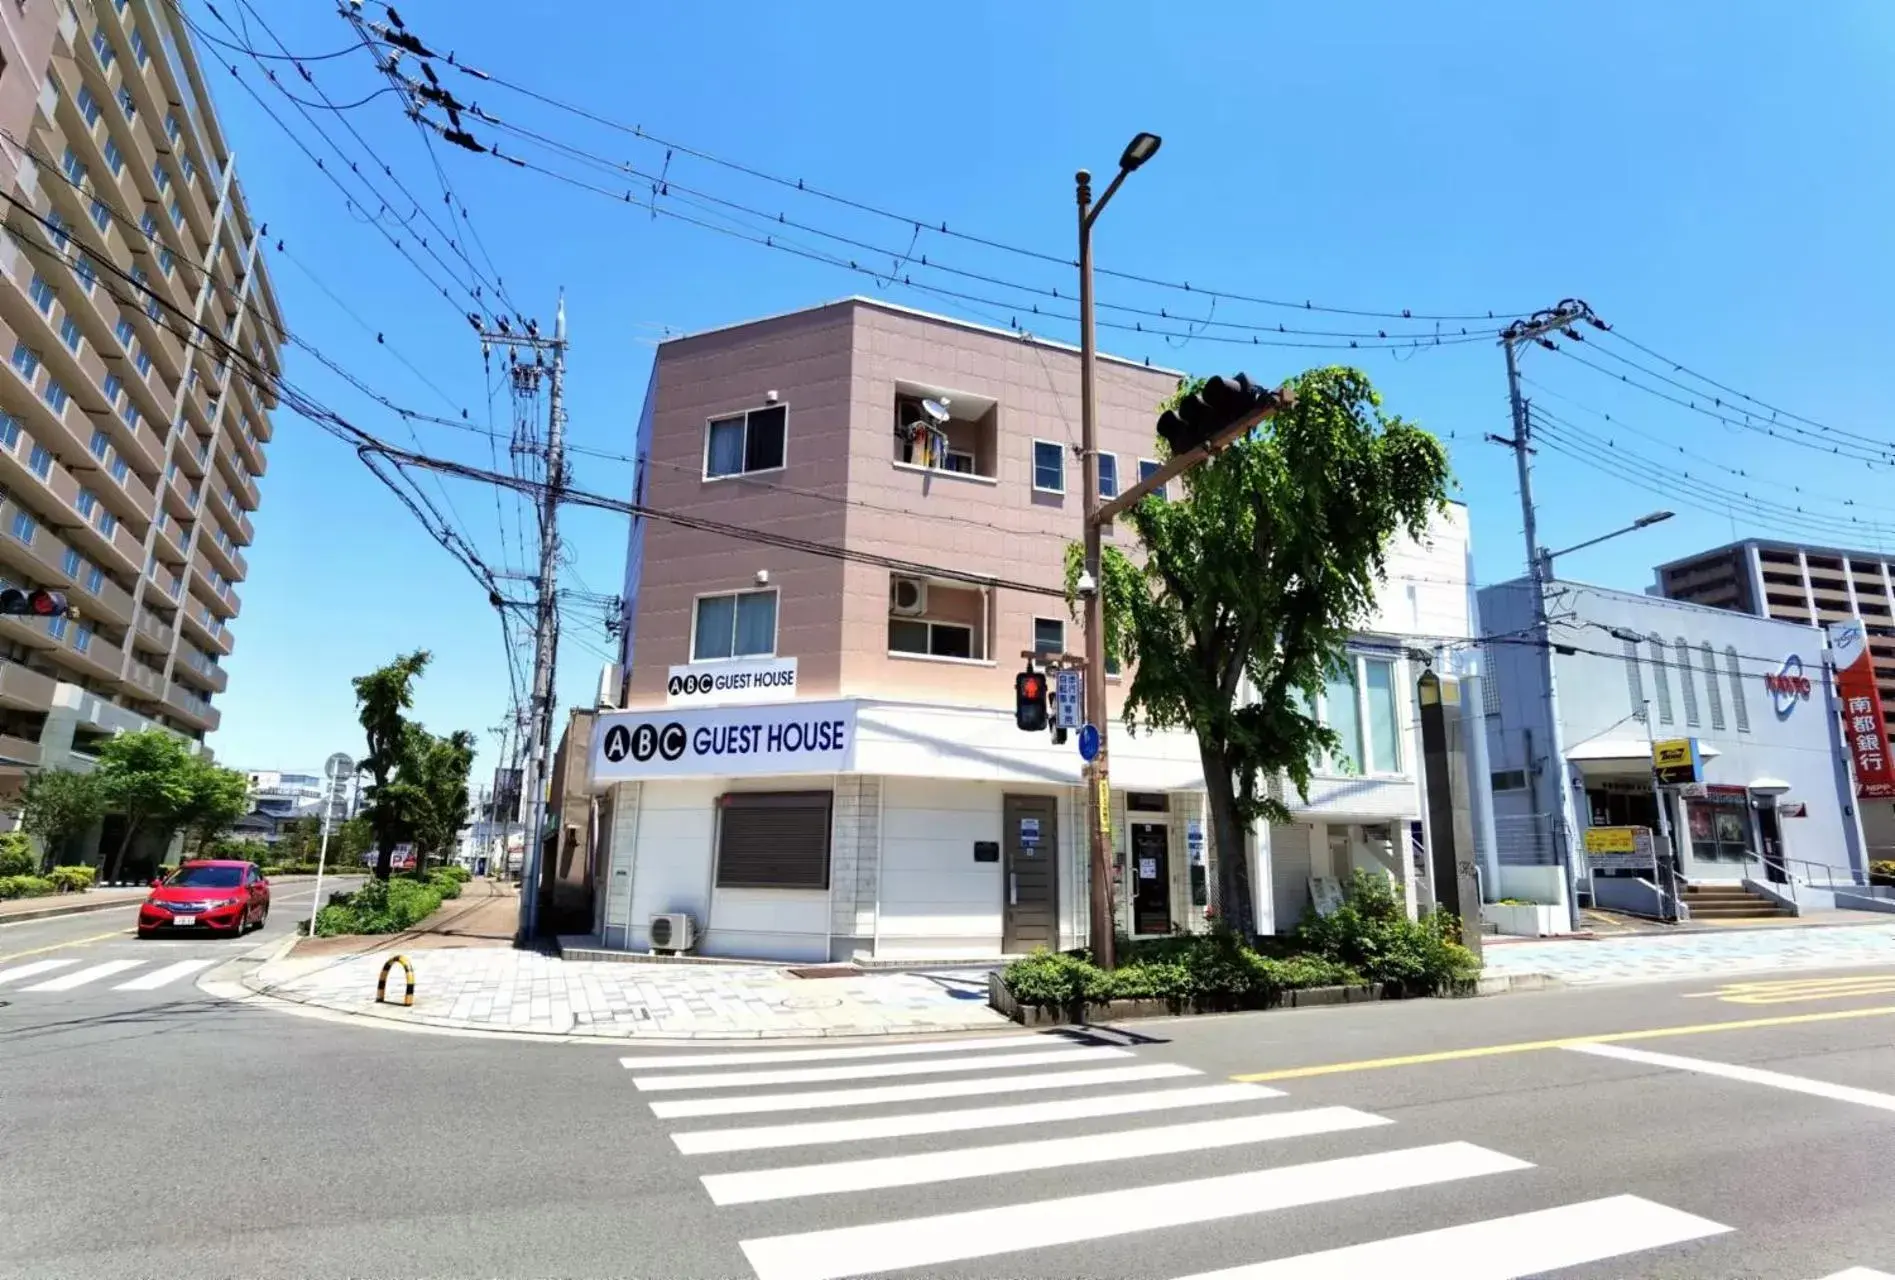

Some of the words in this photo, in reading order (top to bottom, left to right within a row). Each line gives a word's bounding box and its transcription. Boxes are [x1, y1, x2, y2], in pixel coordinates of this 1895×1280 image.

[668, 674, 713, 695] ABC
[715, 674, 751, 690] GUEST
[753, 671, 794, 687] HOUSE
[604, 723, 686, 761] ABC
[693, 725, 762, 755] GUEST
[767, 721, 844, 752] HOUSE
[1848, 697, 1883, 771] 南都銀行
